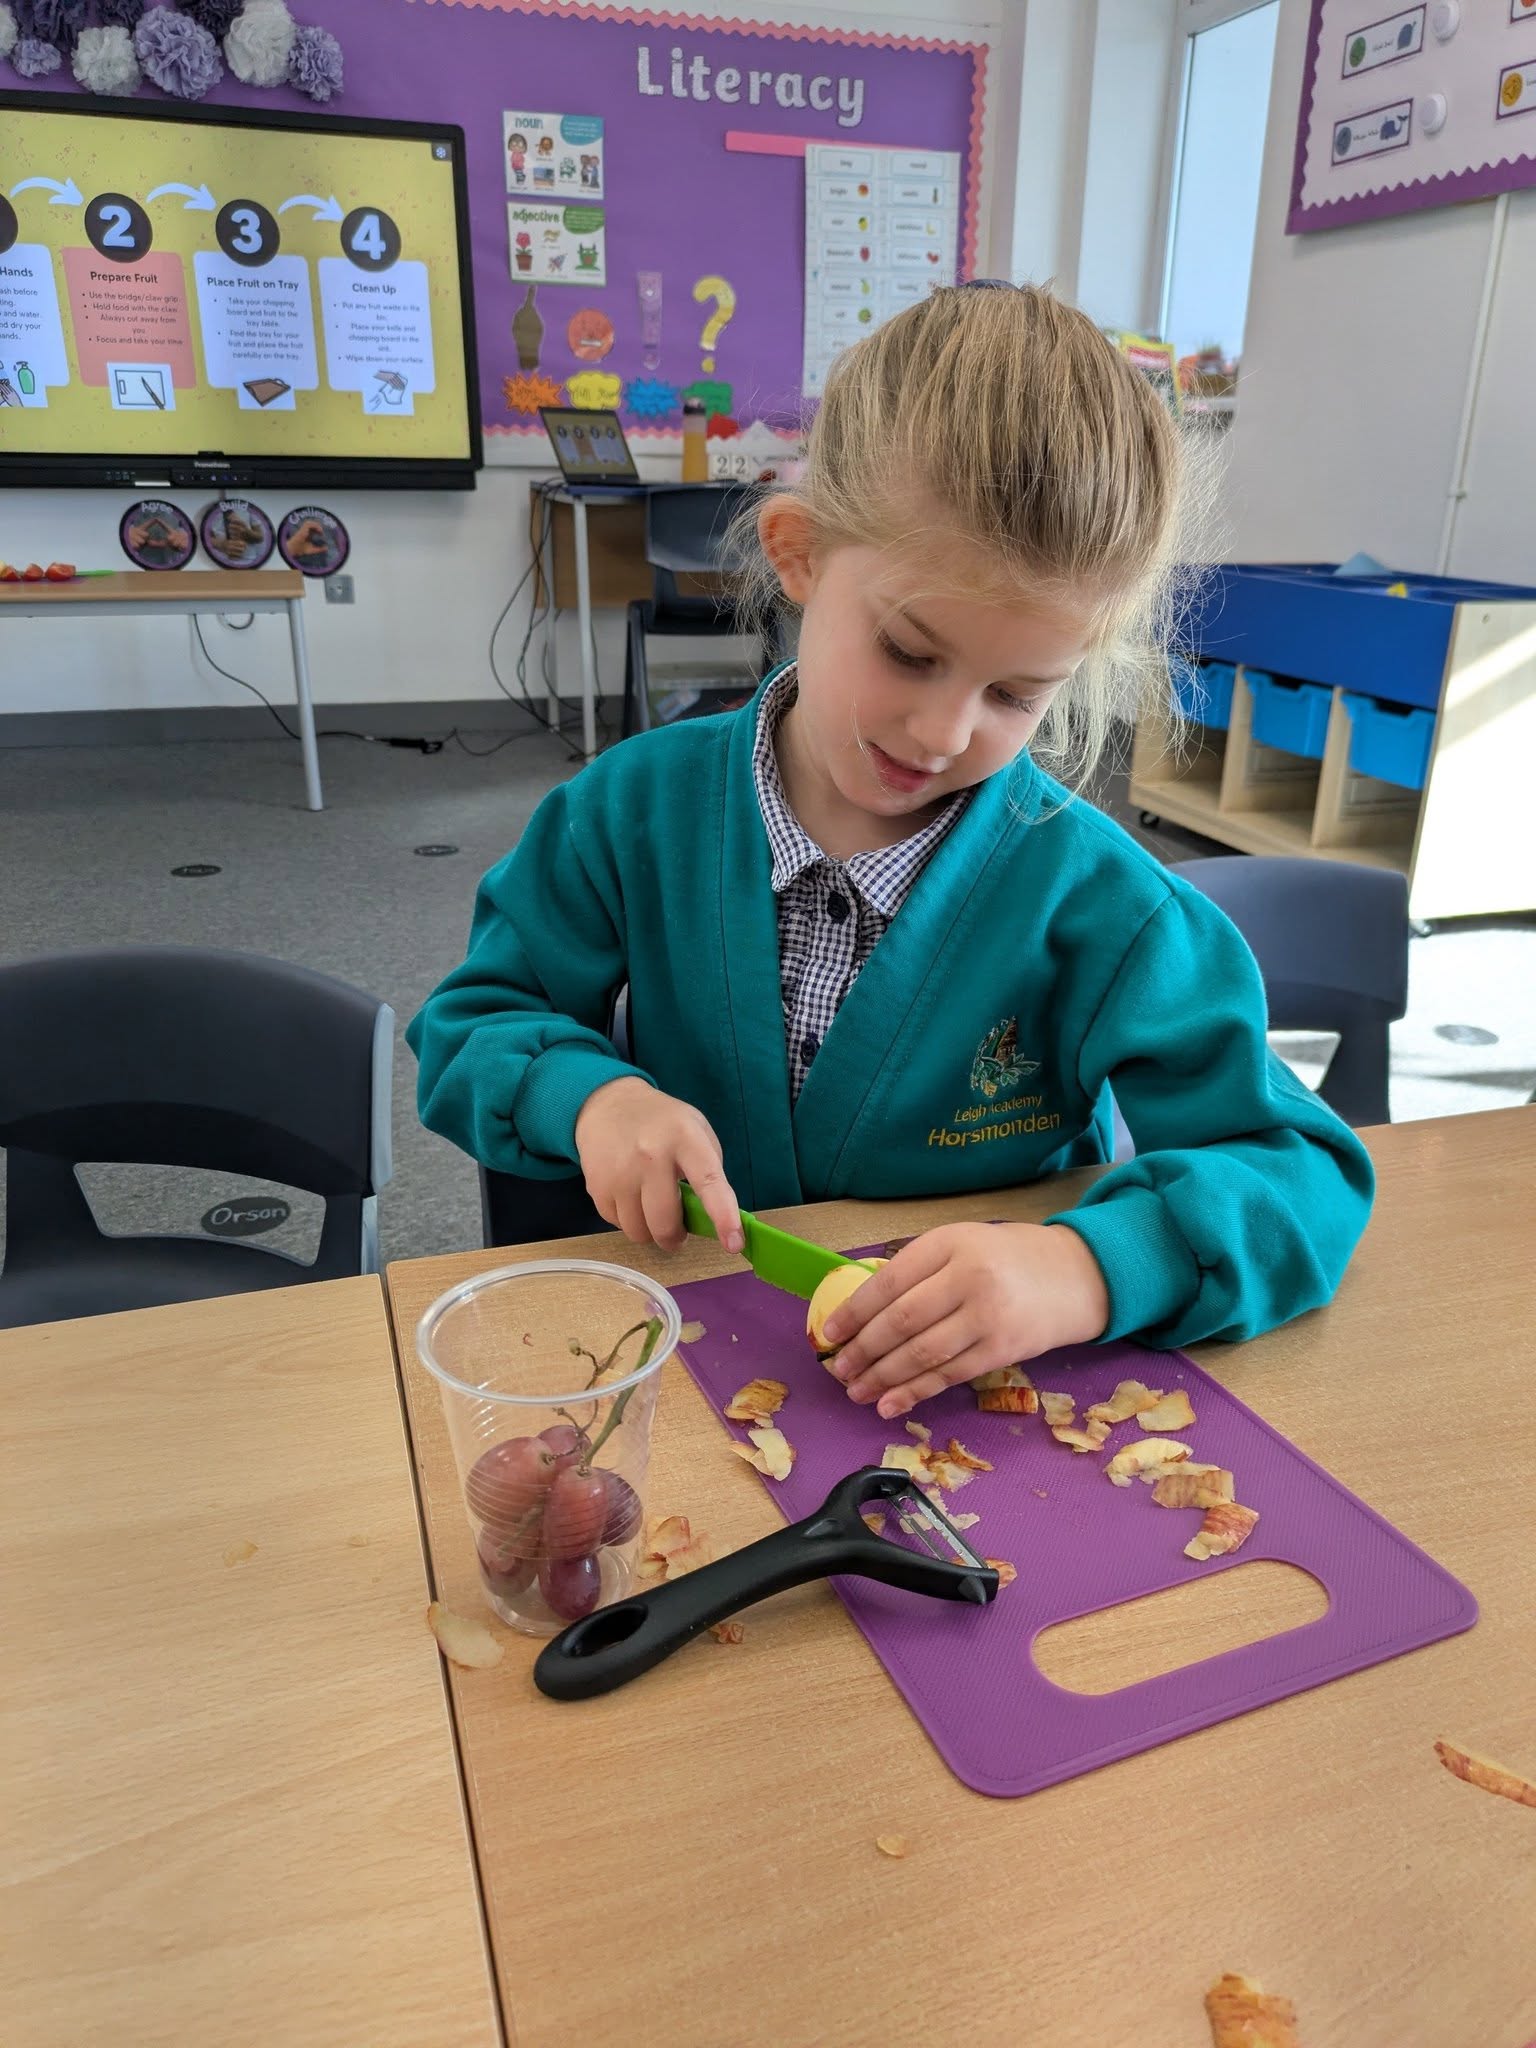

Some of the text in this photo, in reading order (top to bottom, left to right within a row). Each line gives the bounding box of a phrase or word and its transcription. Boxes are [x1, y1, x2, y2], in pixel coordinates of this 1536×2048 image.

[637, 46, 865, 127] Literacy
[514, 117, 544, 129] noun
[512, 208, 560, 224] adjective
[99, 205, 136, 248] 2
[230, 208, 263, 254] 3
[351, 214, 387, 260] 4
[0, 266, 33, 277] Hands
[90, 271, 158, 283] Prepare Fruit
[207, 277, 299, 292] Place Fruit on Tray
[352, 283, 396, 295] Clean Up
[13, 287, 38, 296] before
[89, 291, 102, 299] Use
[104, 292, 116, 300] the
[92, 303, 111, 311] Hold
[112, 303, 129, 311] food
[132, 304, 147, 312] with
[148, 305, 159, 313] the
[100, 314, 126, 323] Always
[10, 321, 22, 331] dry
[96, 335, 117, 343] Focus
[140, 501, 174, 513] Agree
[218, 499, 249, 511] Build
[954, 1094, 1043, 1123] Leigh Academy
[928, 1112, 1061, 1147] Horsmonden
